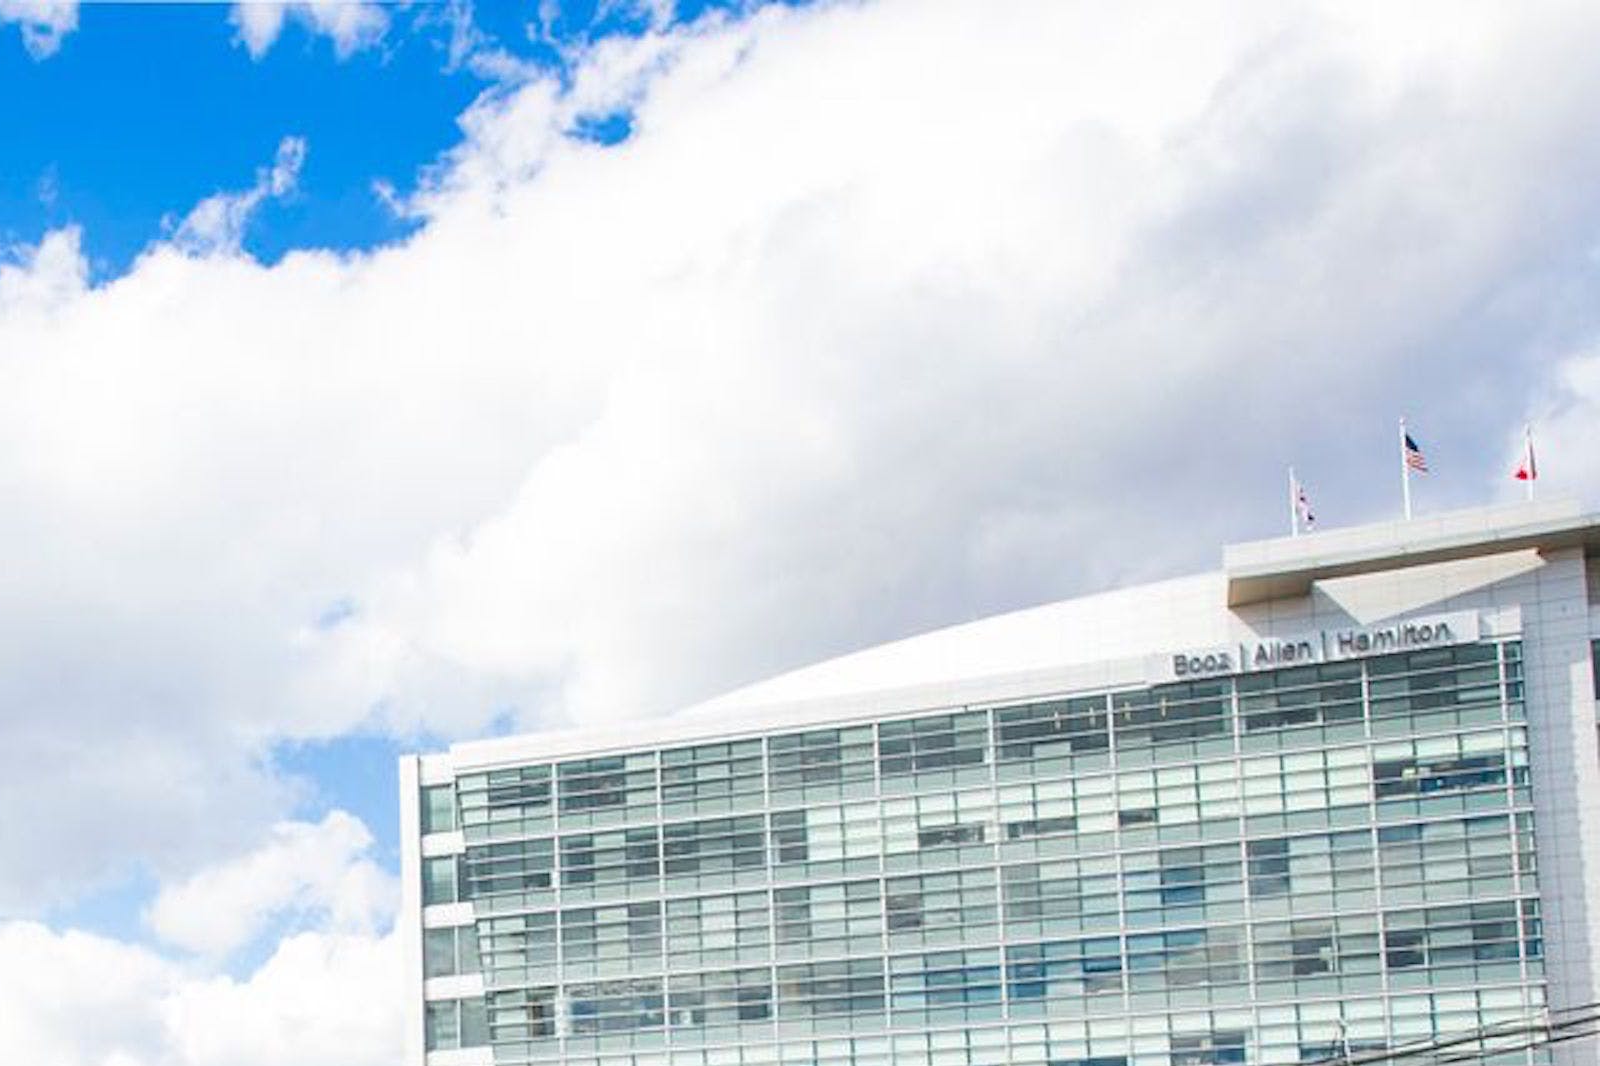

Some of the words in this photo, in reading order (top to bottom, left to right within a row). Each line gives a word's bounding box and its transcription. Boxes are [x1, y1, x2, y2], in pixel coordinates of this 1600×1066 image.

[1173, 652, 1230, 676] Booz
[1254, 641, 1311, 665] Allen
[1337, 619, 1450, 652] Hamilton
